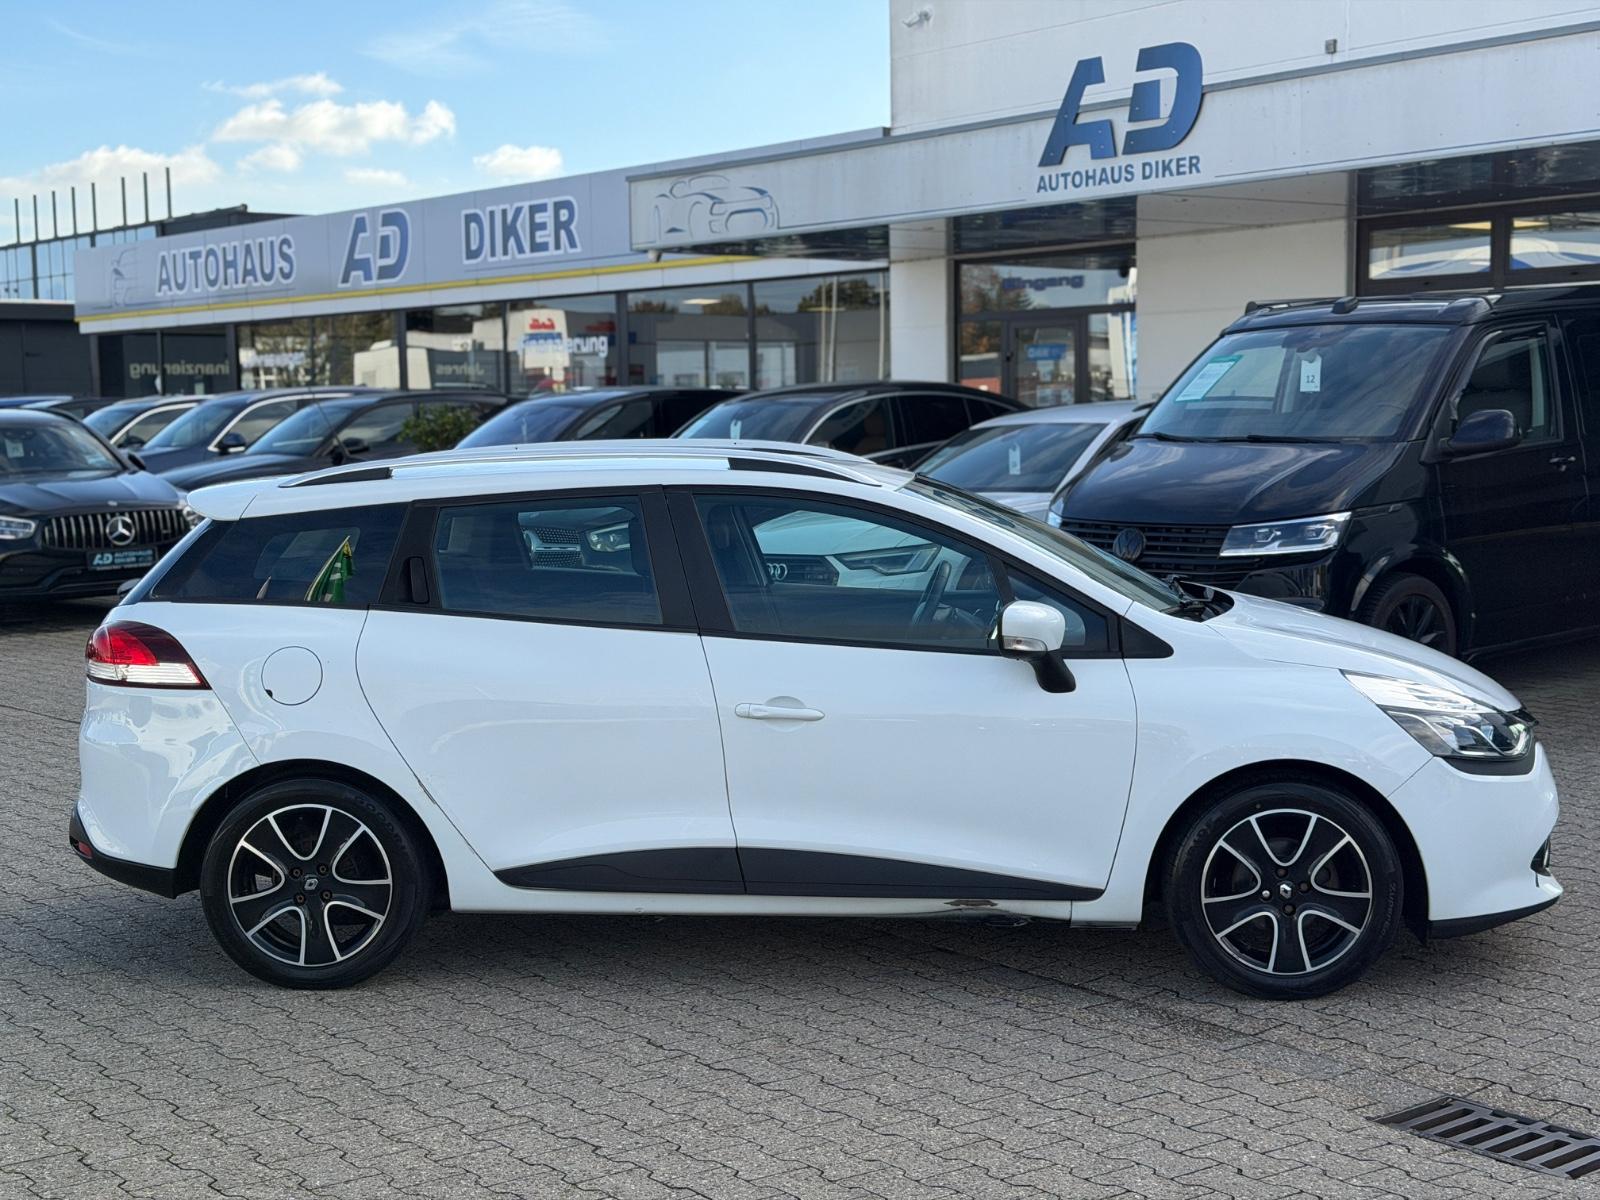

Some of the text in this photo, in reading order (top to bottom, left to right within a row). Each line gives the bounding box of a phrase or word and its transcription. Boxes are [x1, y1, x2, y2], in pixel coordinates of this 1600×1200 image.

[1038, 42, 1203, 167] AD
[1037, 155, 1201, 193] AUTOHAUS DIKER
[157, 197, 580, 296] AUTOHAUS AD DIKER
[1003, 275, 1084, 291] Eingang
[1305, 374, 1316, 384] 12
